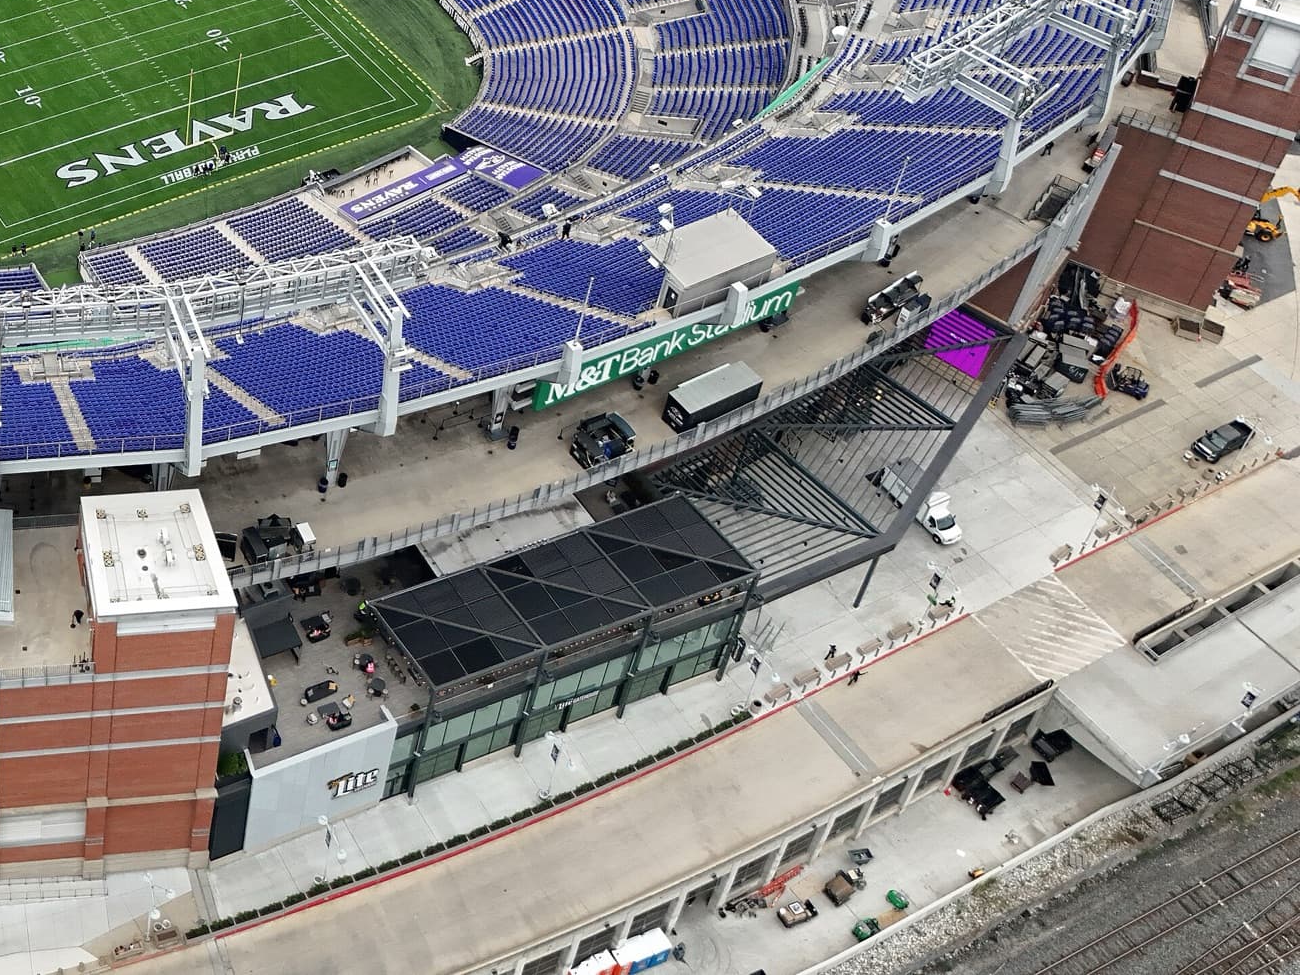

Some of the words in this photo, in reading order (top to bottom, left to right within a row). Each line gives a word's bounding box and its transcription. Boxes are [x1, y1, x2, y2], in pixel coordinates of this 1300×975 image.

[206, 28, 233, 49] 10
[15, 85, 41, 105] 10
[56, 92, 316, 188] RAVENS
[350, 179, 419, 214] RAVENS
[618, 331, 687, 375] Bank
